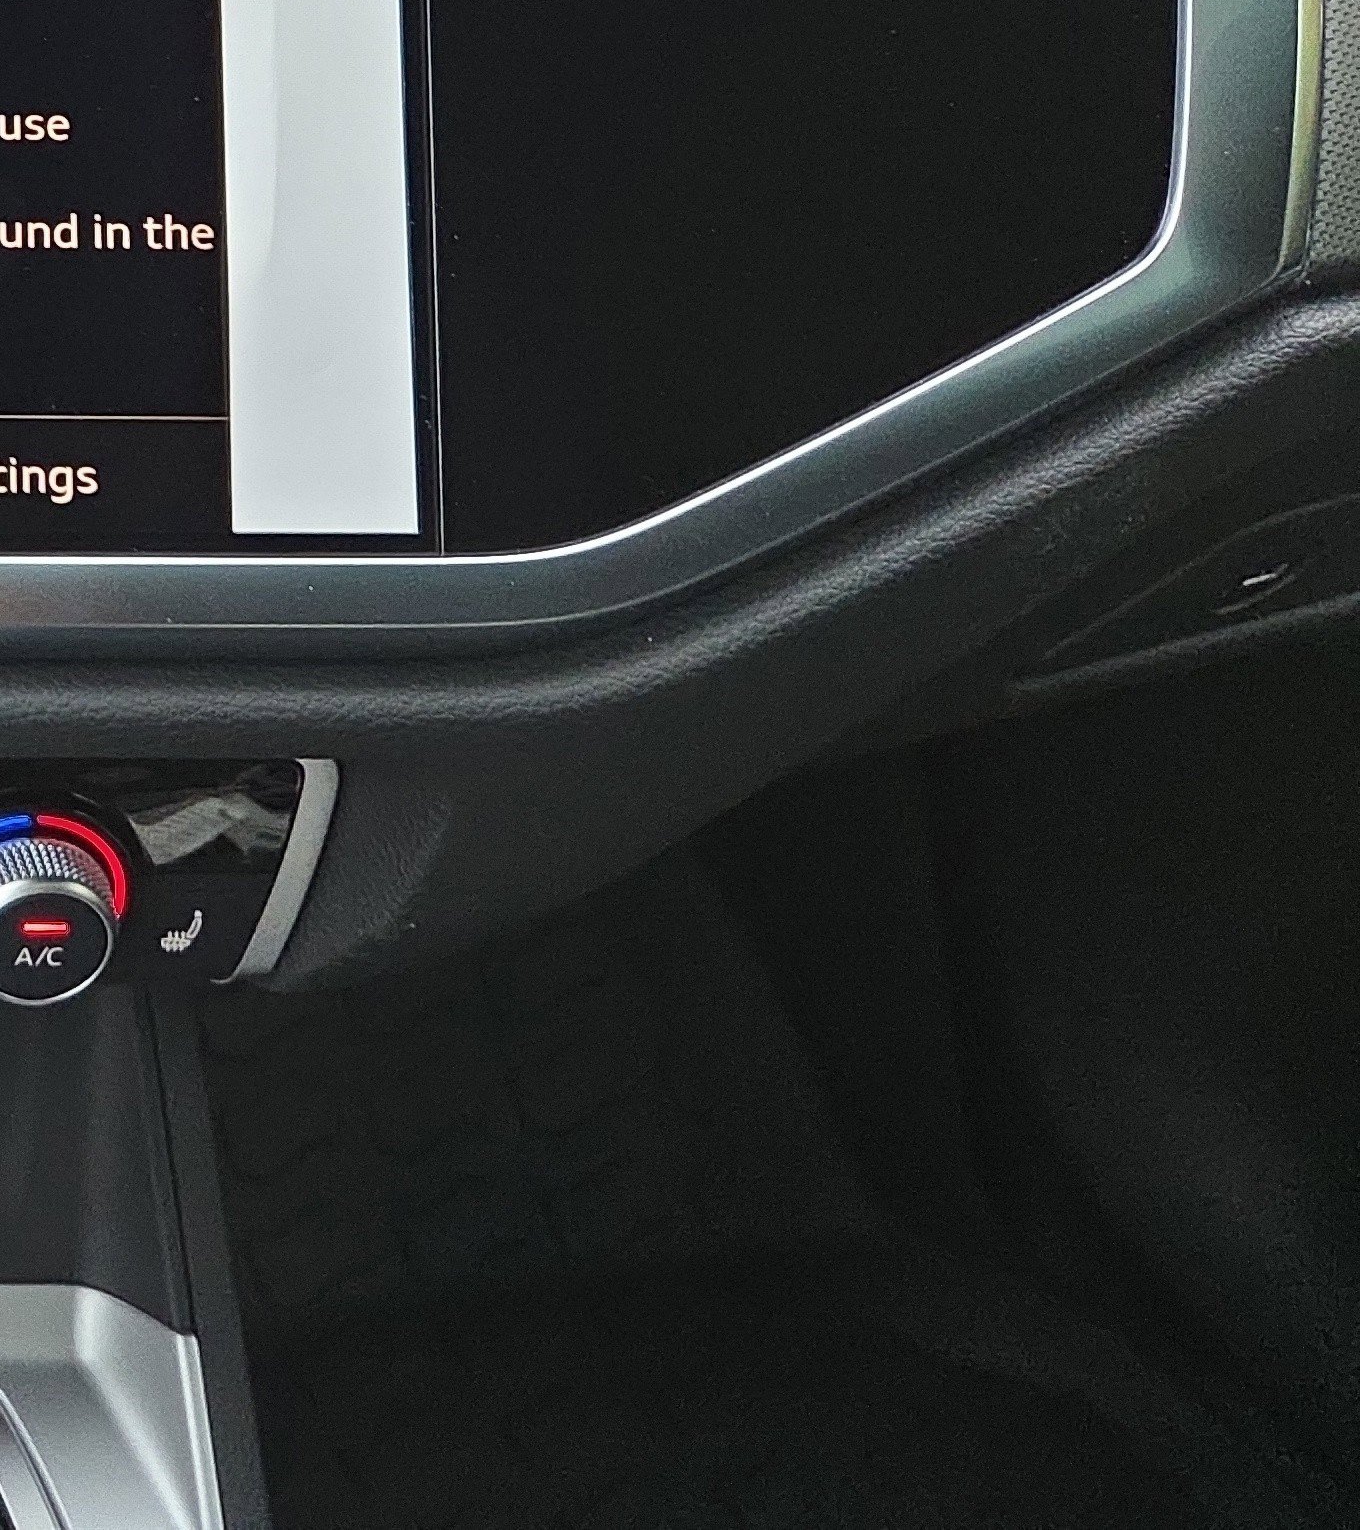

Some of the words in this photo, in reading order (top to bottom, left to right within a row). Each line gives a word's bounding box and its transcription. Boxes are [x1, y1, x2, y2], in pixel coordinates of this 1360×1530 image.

[93, 213, 131, 250] in
[143, 214, 215, 251] the
[14, 946, 64, 967] A/C
